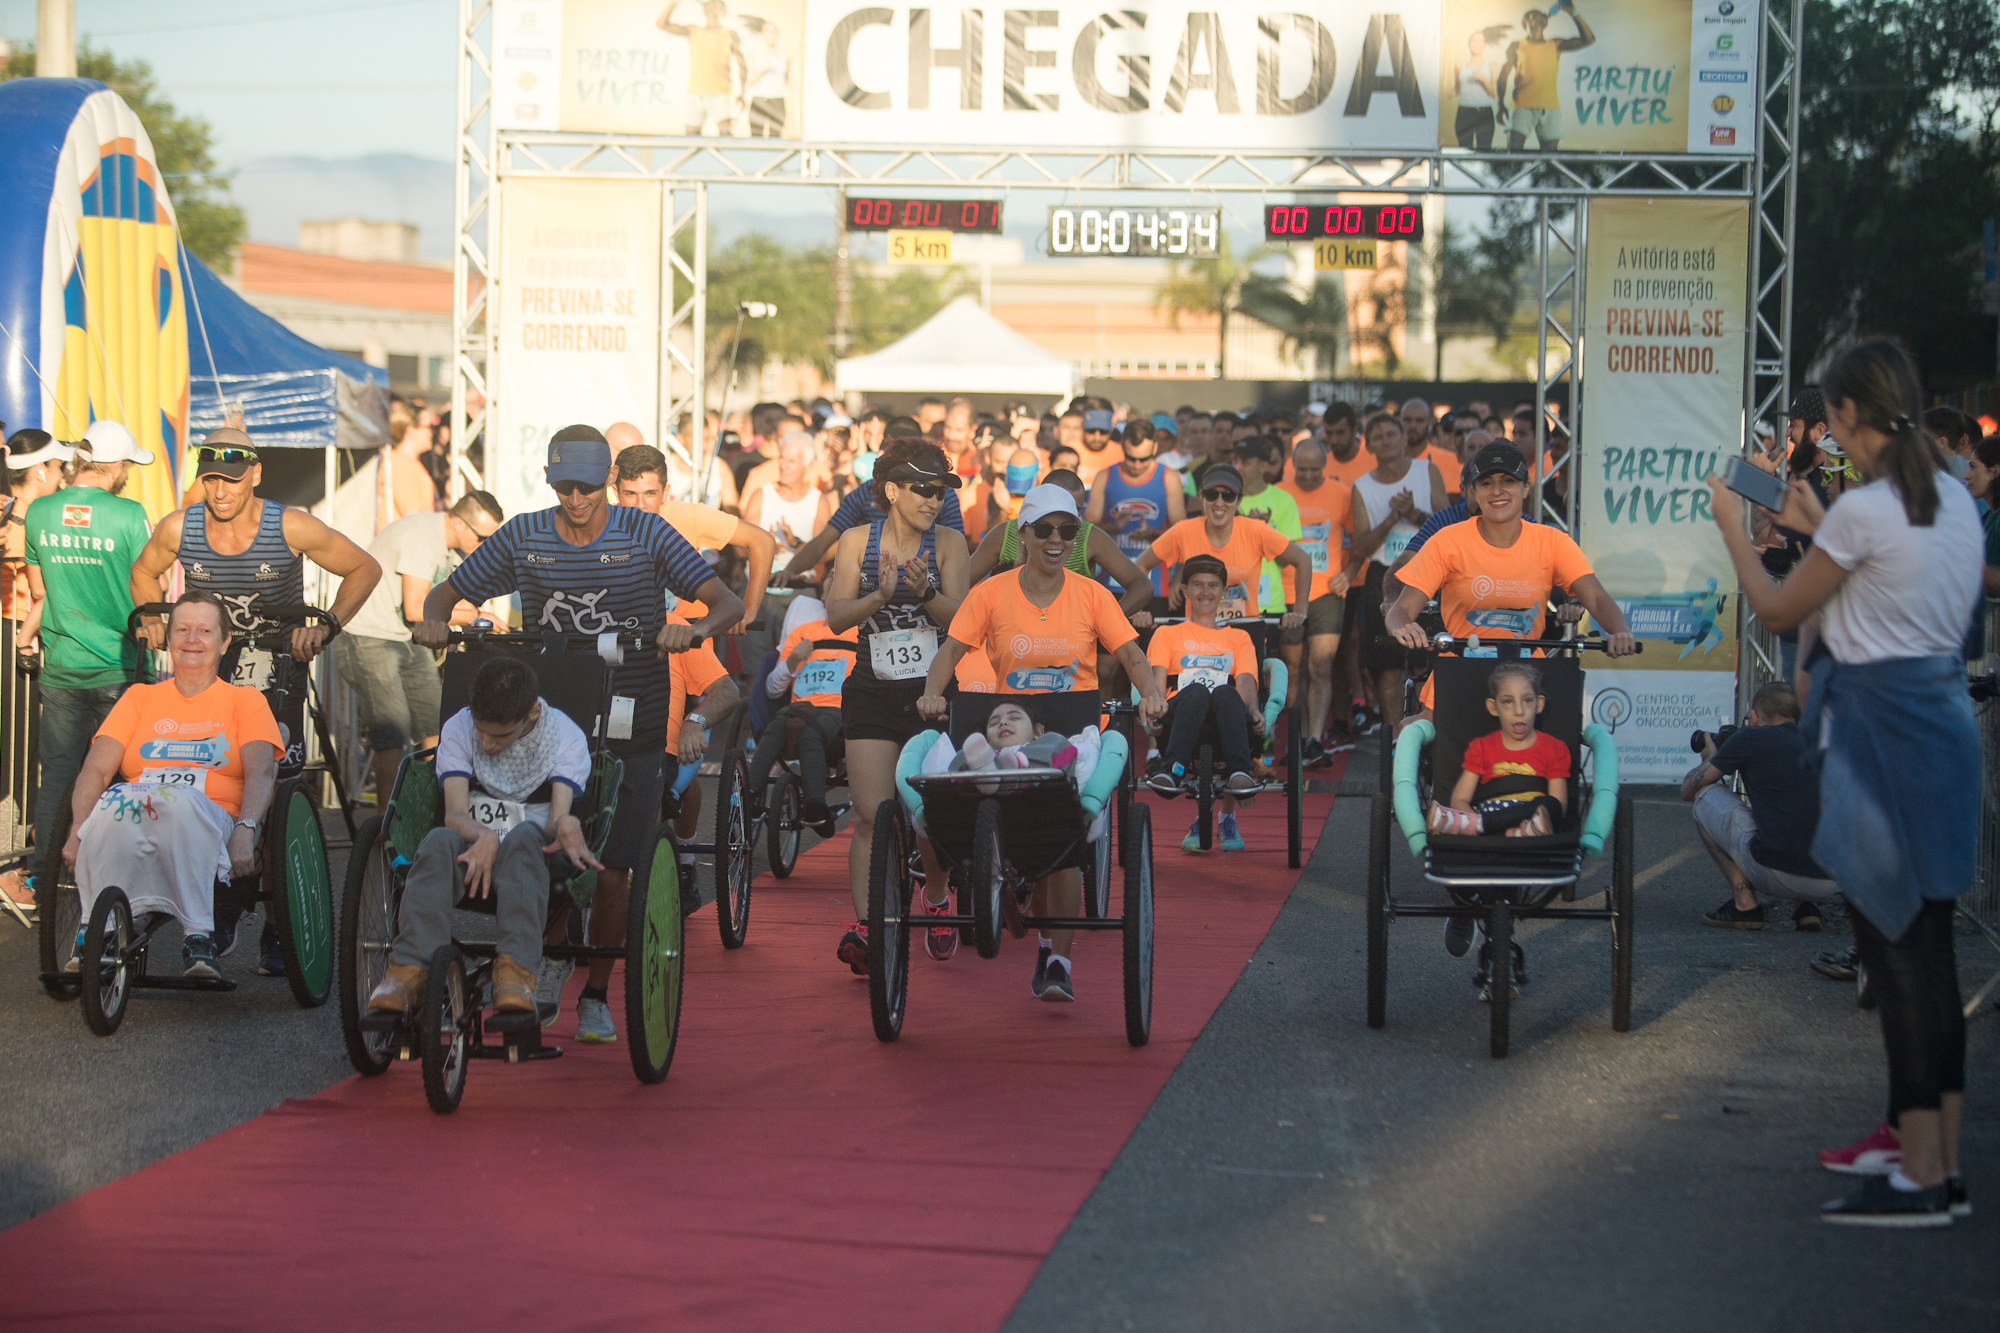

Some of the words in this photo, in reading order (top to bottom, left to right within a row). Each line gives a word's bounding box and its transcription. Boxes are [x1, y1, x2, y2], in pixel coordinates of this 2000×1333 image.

[1723, 17, 1746, 25] Import
[576, 48, 670, 76] PARTIU
[826, 7, 1427, 118] CHEGADA
[576, 78, 671, 106] VIVER
[1574, 64, 1674, 96] PARTIU
[1575, 96, 1673, 126] VIVER
[854, 199, 893, 225] 00
[1271, 206, 1309, 234] 00
[1324, 206, 1362, 234] 00
[1379, 206, 1416, 234] 00
[1052, 209, 1217, 254] 00:04:34
[894, 236, 906, 259] 5
[914, 237, 948, 260] km
[1316, 244, 1338, 266] 10
[1345, 244, 1374, 266] km
[1617, 246, 1627, 270] A
[1631, 246, 1679, 271] vitória
[1683, 246, 1716, 272] está
[521, 286, 637, 317] PREVINA-SE
[1613, 277, 1632, 300] na
[1636, 276, 1718, 308] prevenção.
[1606, 307, 1725, 338] PREVINA-SE
[522, 323, 633, 353] CORRENDO.
[1607, 343, 1720, 375] CORRENDO.
[1602, 441, 1721, 486] PARTIU
[1603, 485, 1714, 526] VIVER
[40, 529, 115, 553] ÁRBITRO
[51, 555, 103, 567] ATLETISMO
[1495, 591, 1531, 599] ONCOLOGIA
[1630, 621, 1671, 634] CAMINHADA
[1631, 609, 1672, 623] CORRIDA
[1673, 609, 1680, 624] E
[885, 645, 923, 666] 133
[1033, 643, 1076, 651] HEMATOLOGIA
[803, 671, 835, 684] 1192
[894, 667, 917, 676] LUCIA
[1636, 694, 1679, 706] CENTRO
[1681, 694, 1696, 706] DE
[1636, 705, 1712, 718] HEMATOLOGIA
[1714, 705, 1721, 718] E
[1635, 716, 1700, 729] ONCOLOGIA
[468, 801, 508, 825] 134
